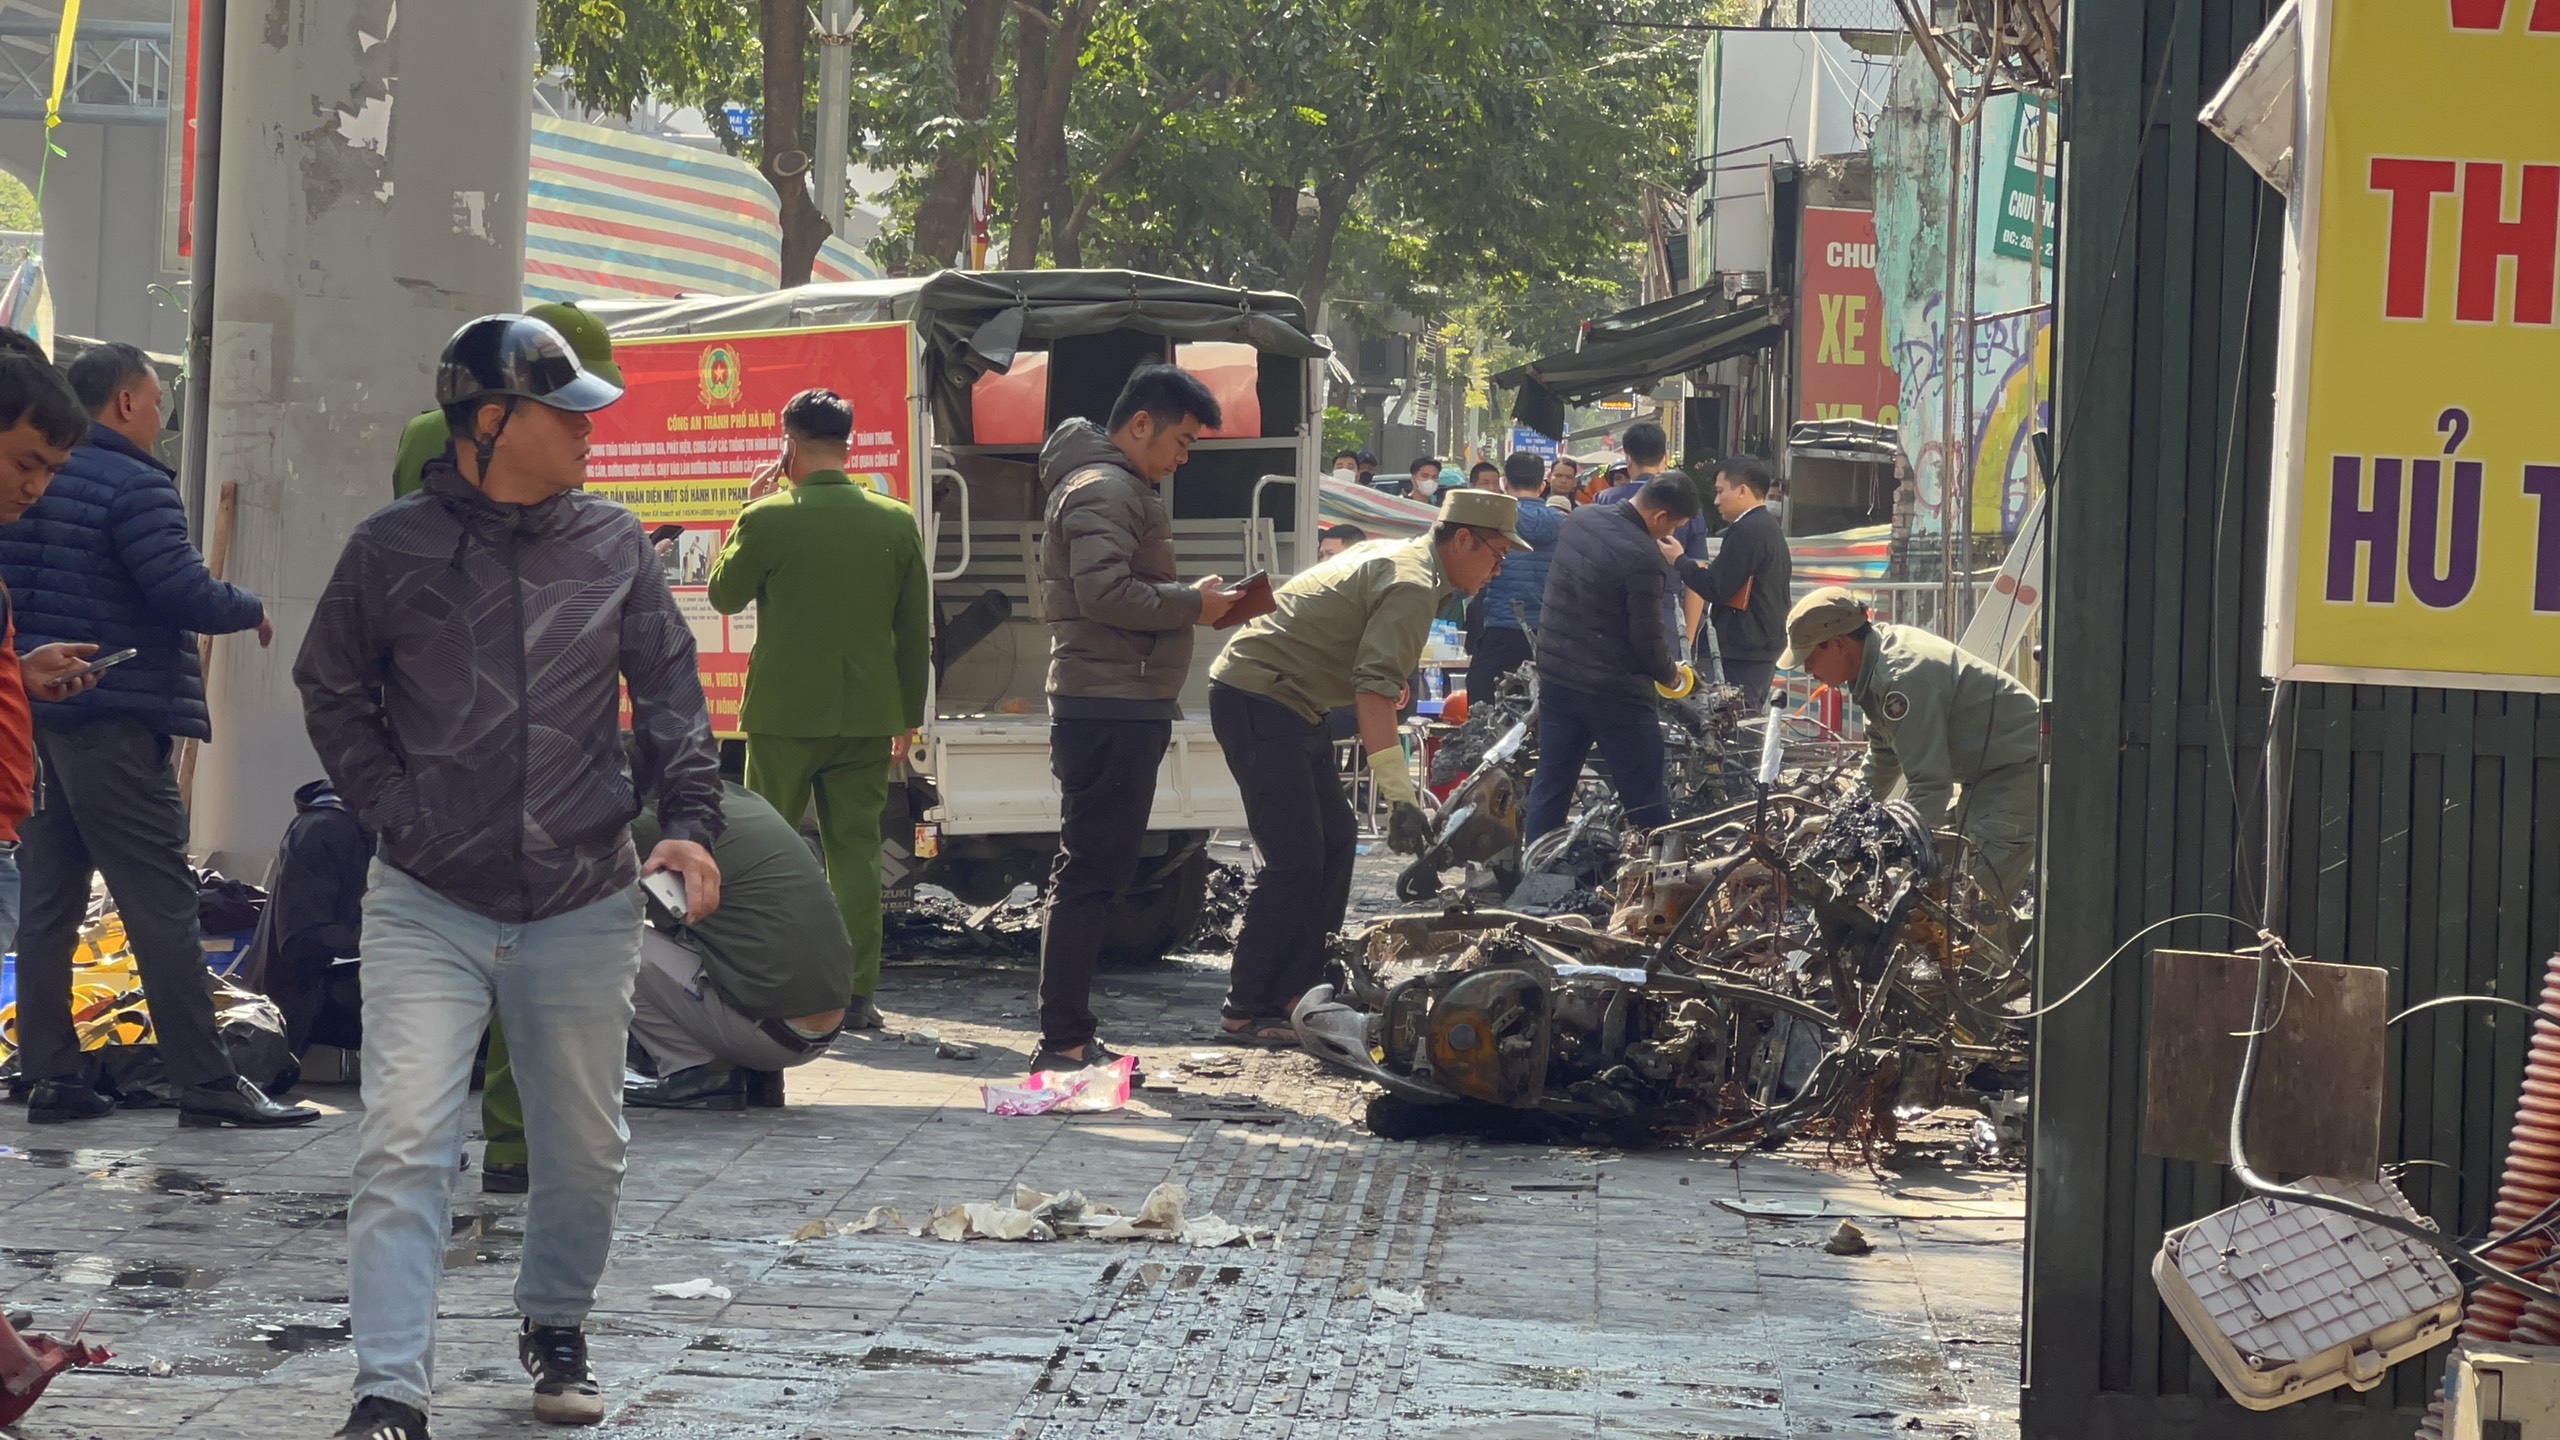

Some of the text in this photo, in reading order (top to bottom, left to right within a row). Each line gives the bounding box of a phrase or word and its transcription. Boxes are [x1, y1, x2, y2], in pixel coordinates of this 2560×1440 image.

[1816, 294, 1866, 366] XE
[667, 408, 776, 432] CÔNG AN THÀNH PHỐ HÀ NỘI
[626, 487, 644, 507] NHẬN
[646, 486, 662, 506] DIỆN
[664, 486, 678, 506] MỘT
[680, 484, 689, 502] SỐ
[690, 486, 710, 502] HÀNH
[711, 488, 718, 502] VI
[719, 488, 726, 501] VI
[2326, 407, 2483, 608] HỦ
[716, 672, 738, 687] VIDEO
[882, 888, 912, 898] ZUKI
